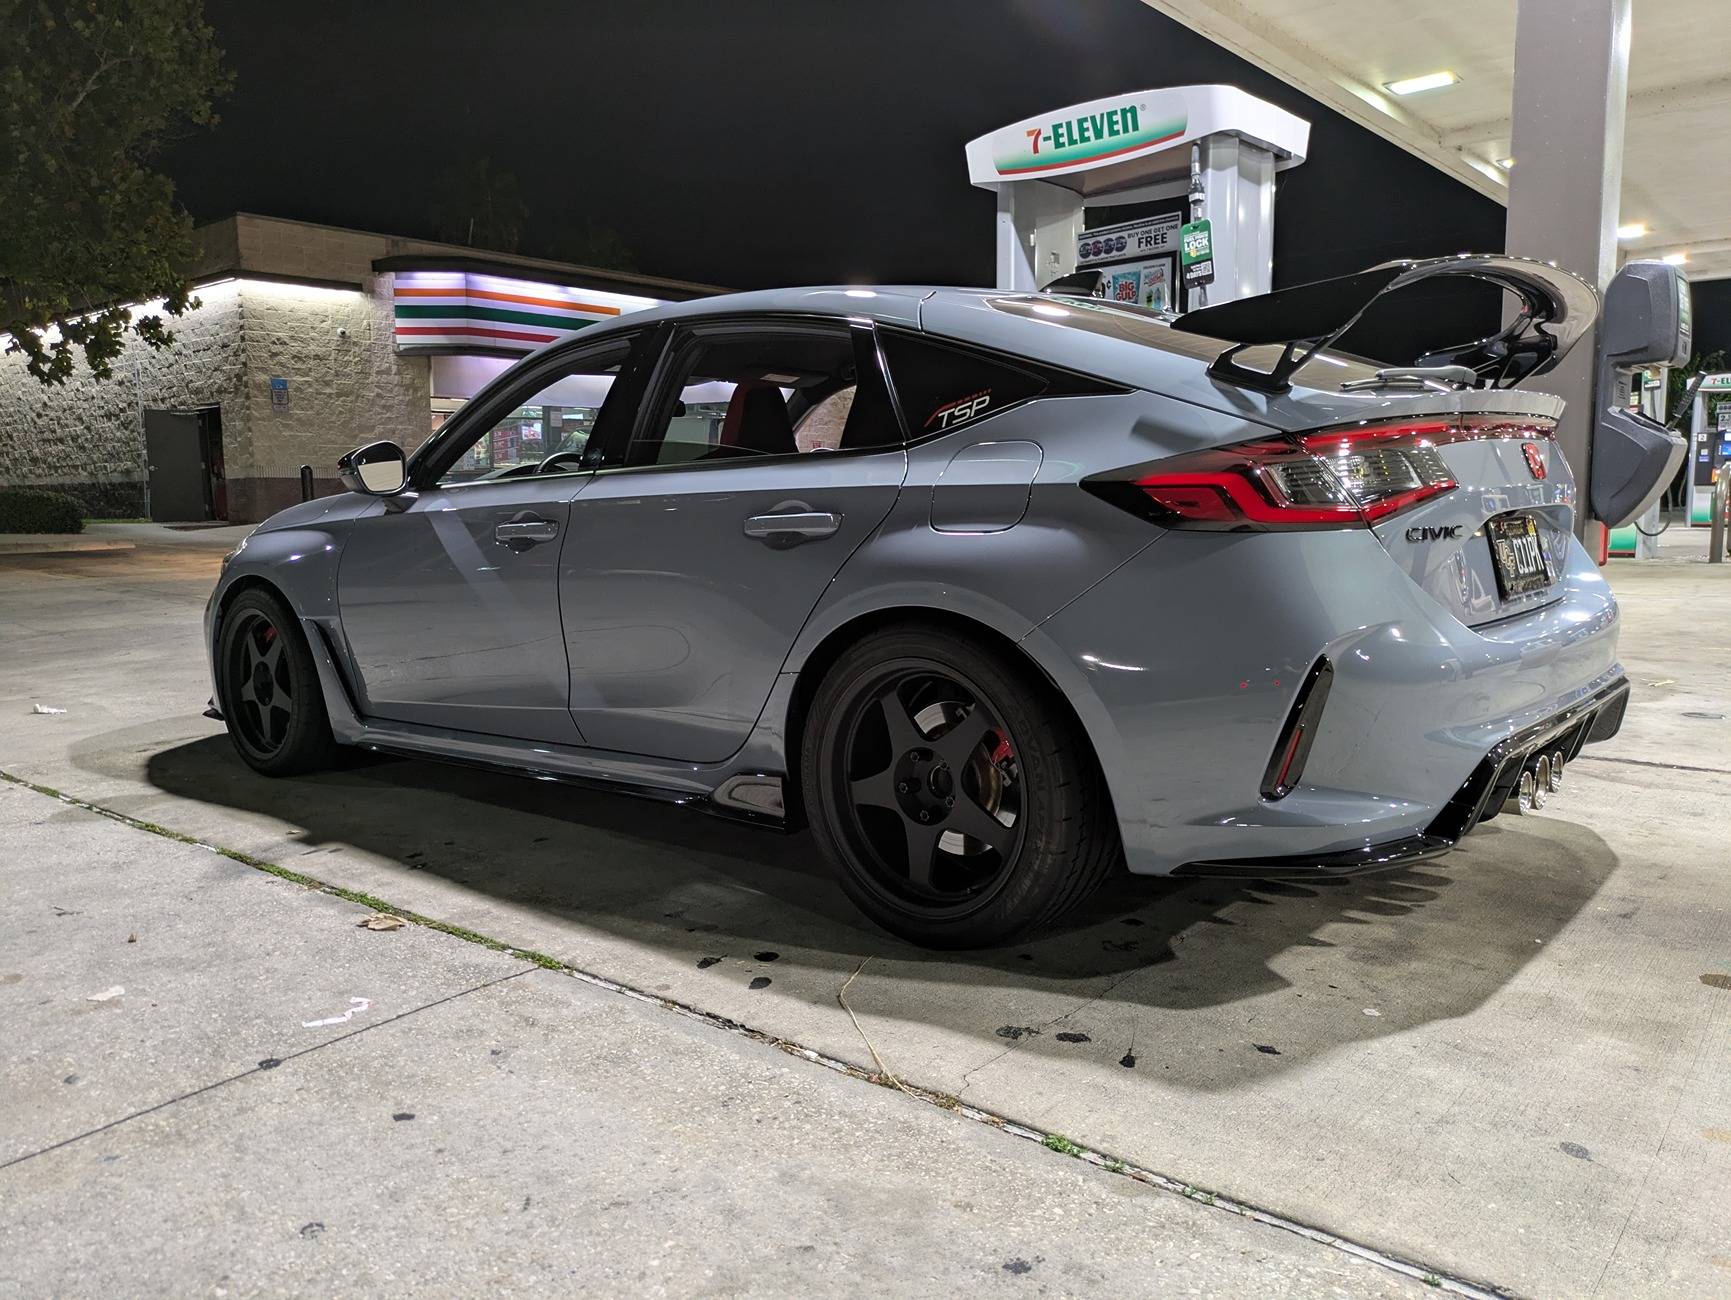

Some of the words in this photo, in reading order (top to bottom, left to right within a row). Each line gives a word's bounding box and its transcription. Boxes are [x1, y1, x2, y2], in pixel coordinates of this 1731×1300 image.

[1127, 231, 1140, 239] BUY
[1153, 226, 1165, 234] GET
[1137, 232, 1168, 249] FREE
[1184, 237, 1209, 251] LOCK
[1116, 290, 1137, 302] GULP
[1711, 376, 1731, 386] 7-EL
[938, 395, 990, 428] TSP
[1405, 525, 1463, 542] CIVIC
